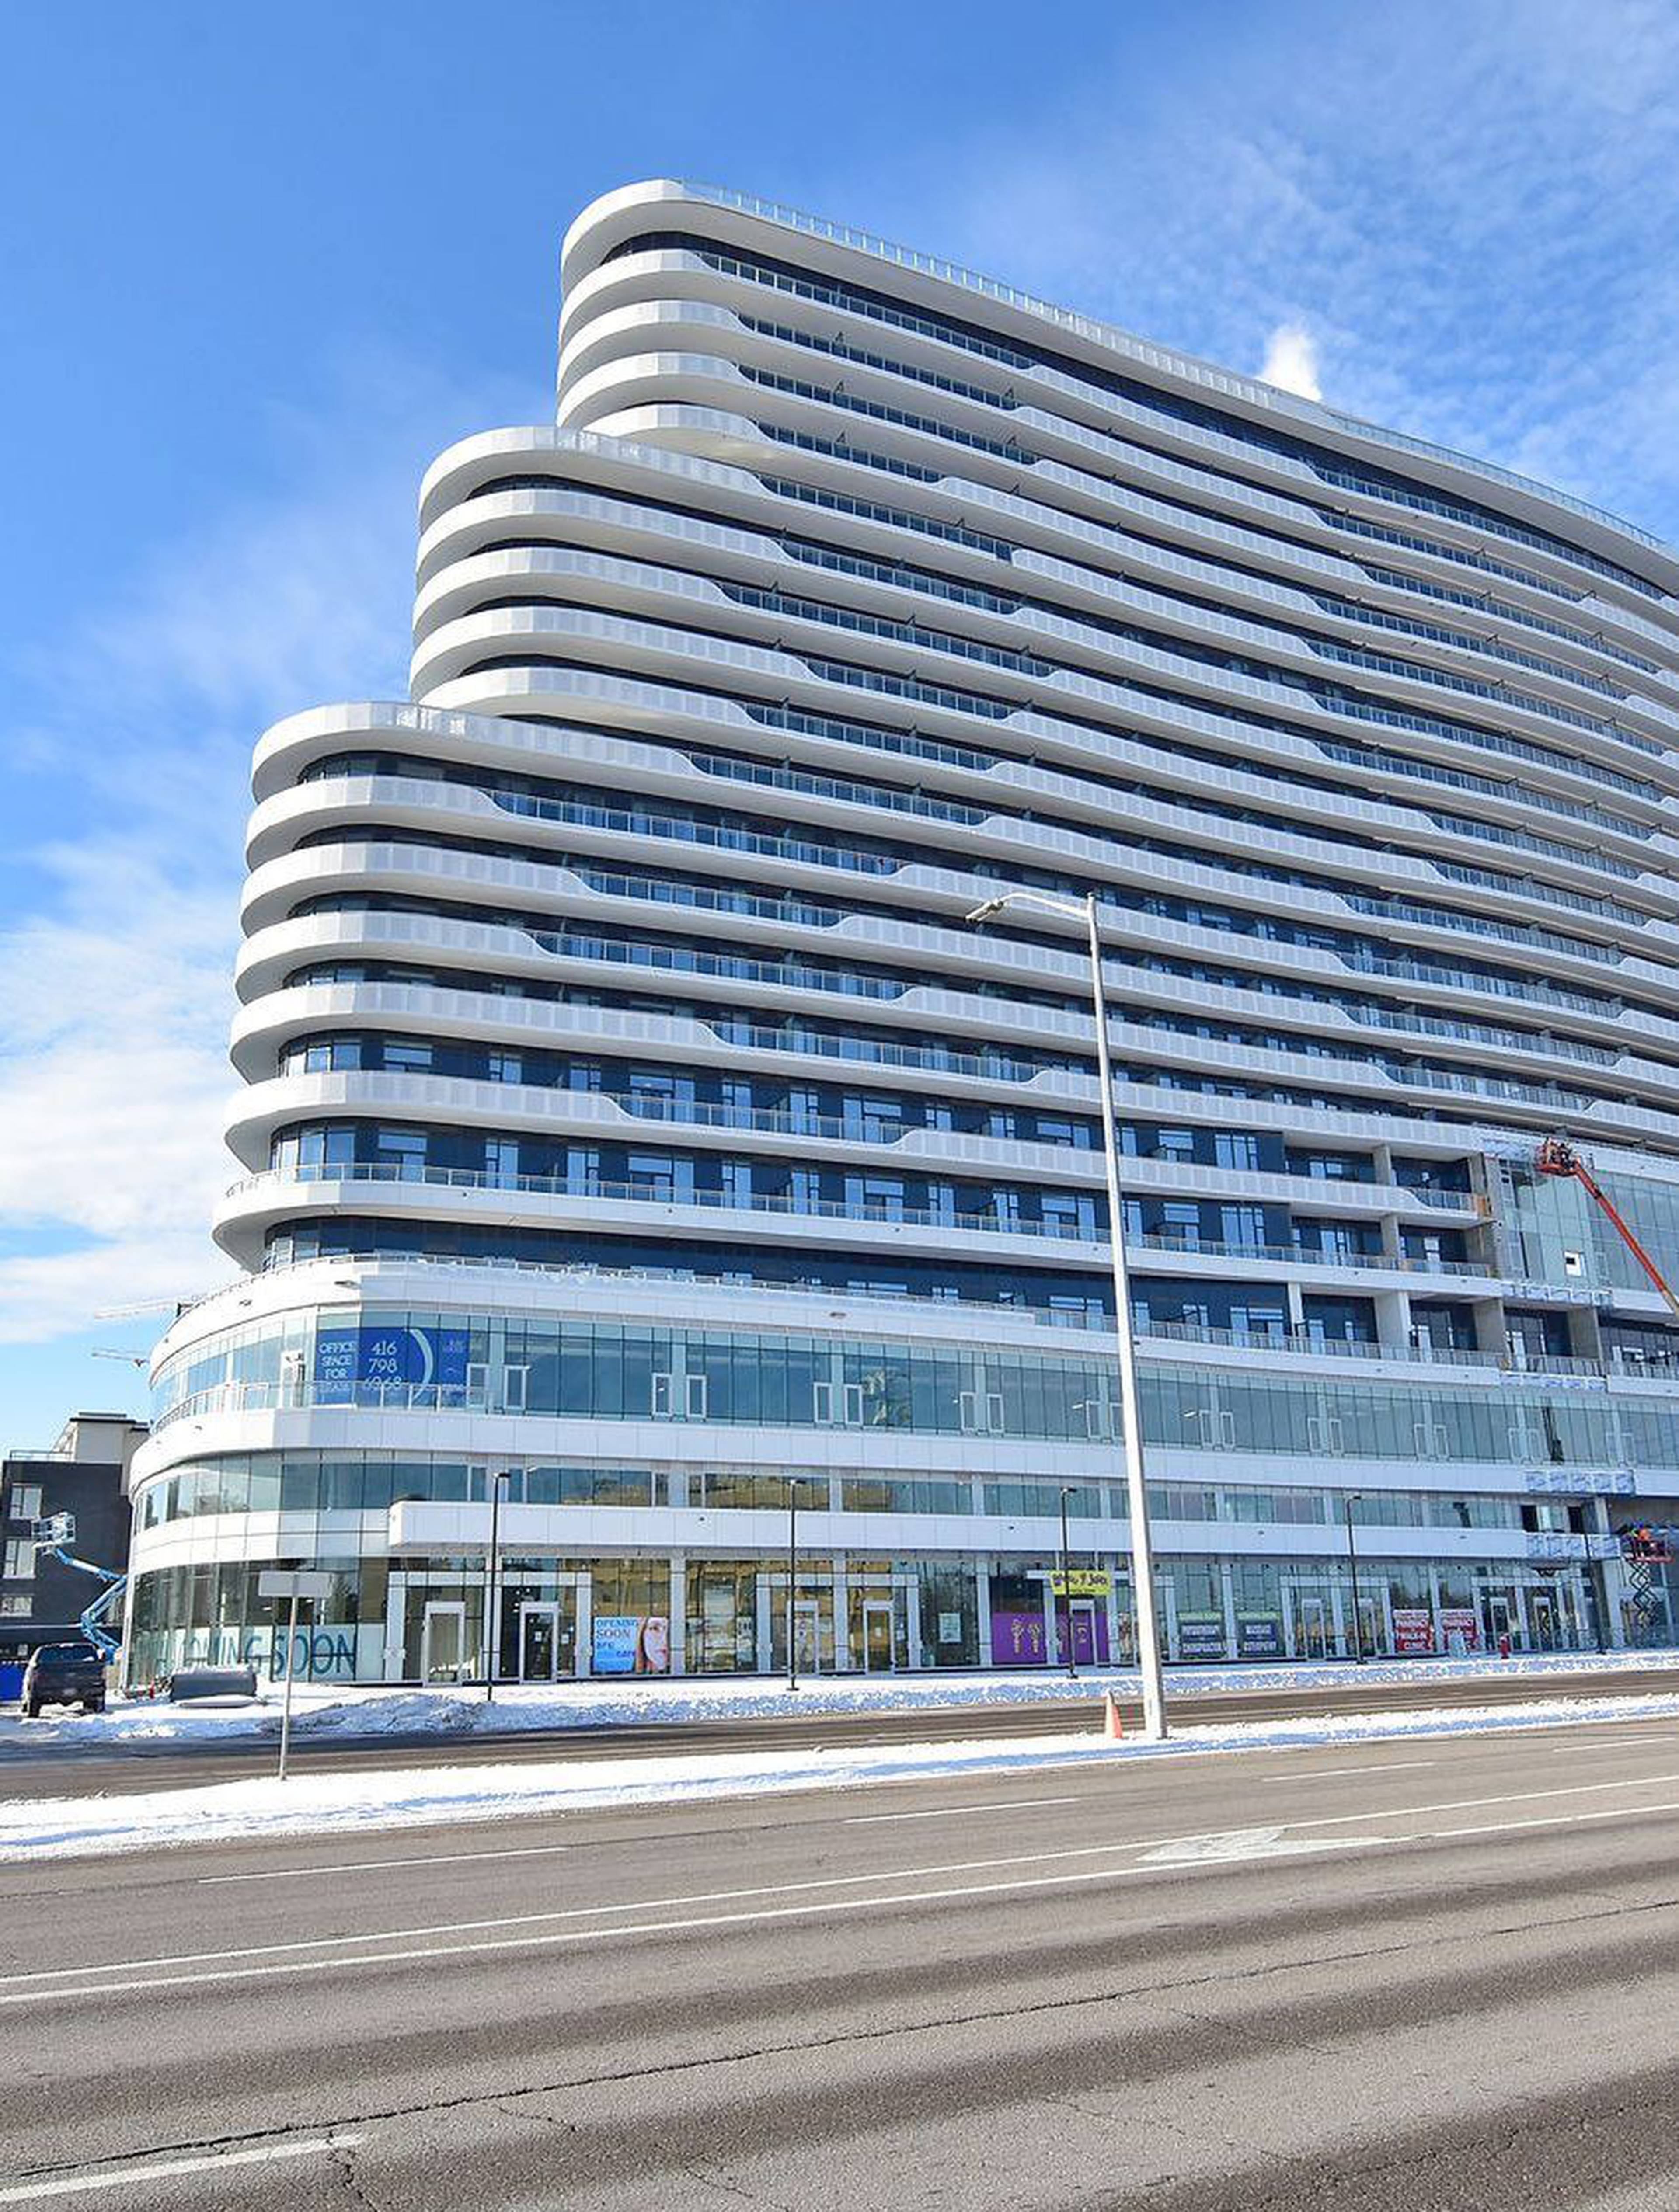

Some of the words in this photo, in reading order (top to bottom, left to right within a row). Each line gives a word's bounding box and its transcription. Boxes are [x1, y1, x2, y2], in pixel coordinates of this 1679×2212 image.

[319, 1341, 358, 1354] OFFICE
[371, 1340, 397, 1355] 416
[321, 1355, 352, 1367] SPACE
[368, 1358, 398, 1374] 798
[325, 1368, 348, 1380] FOR
[596, 1629, 631, 1639] SOON
[274, 1633, 355, 1675] SOON
